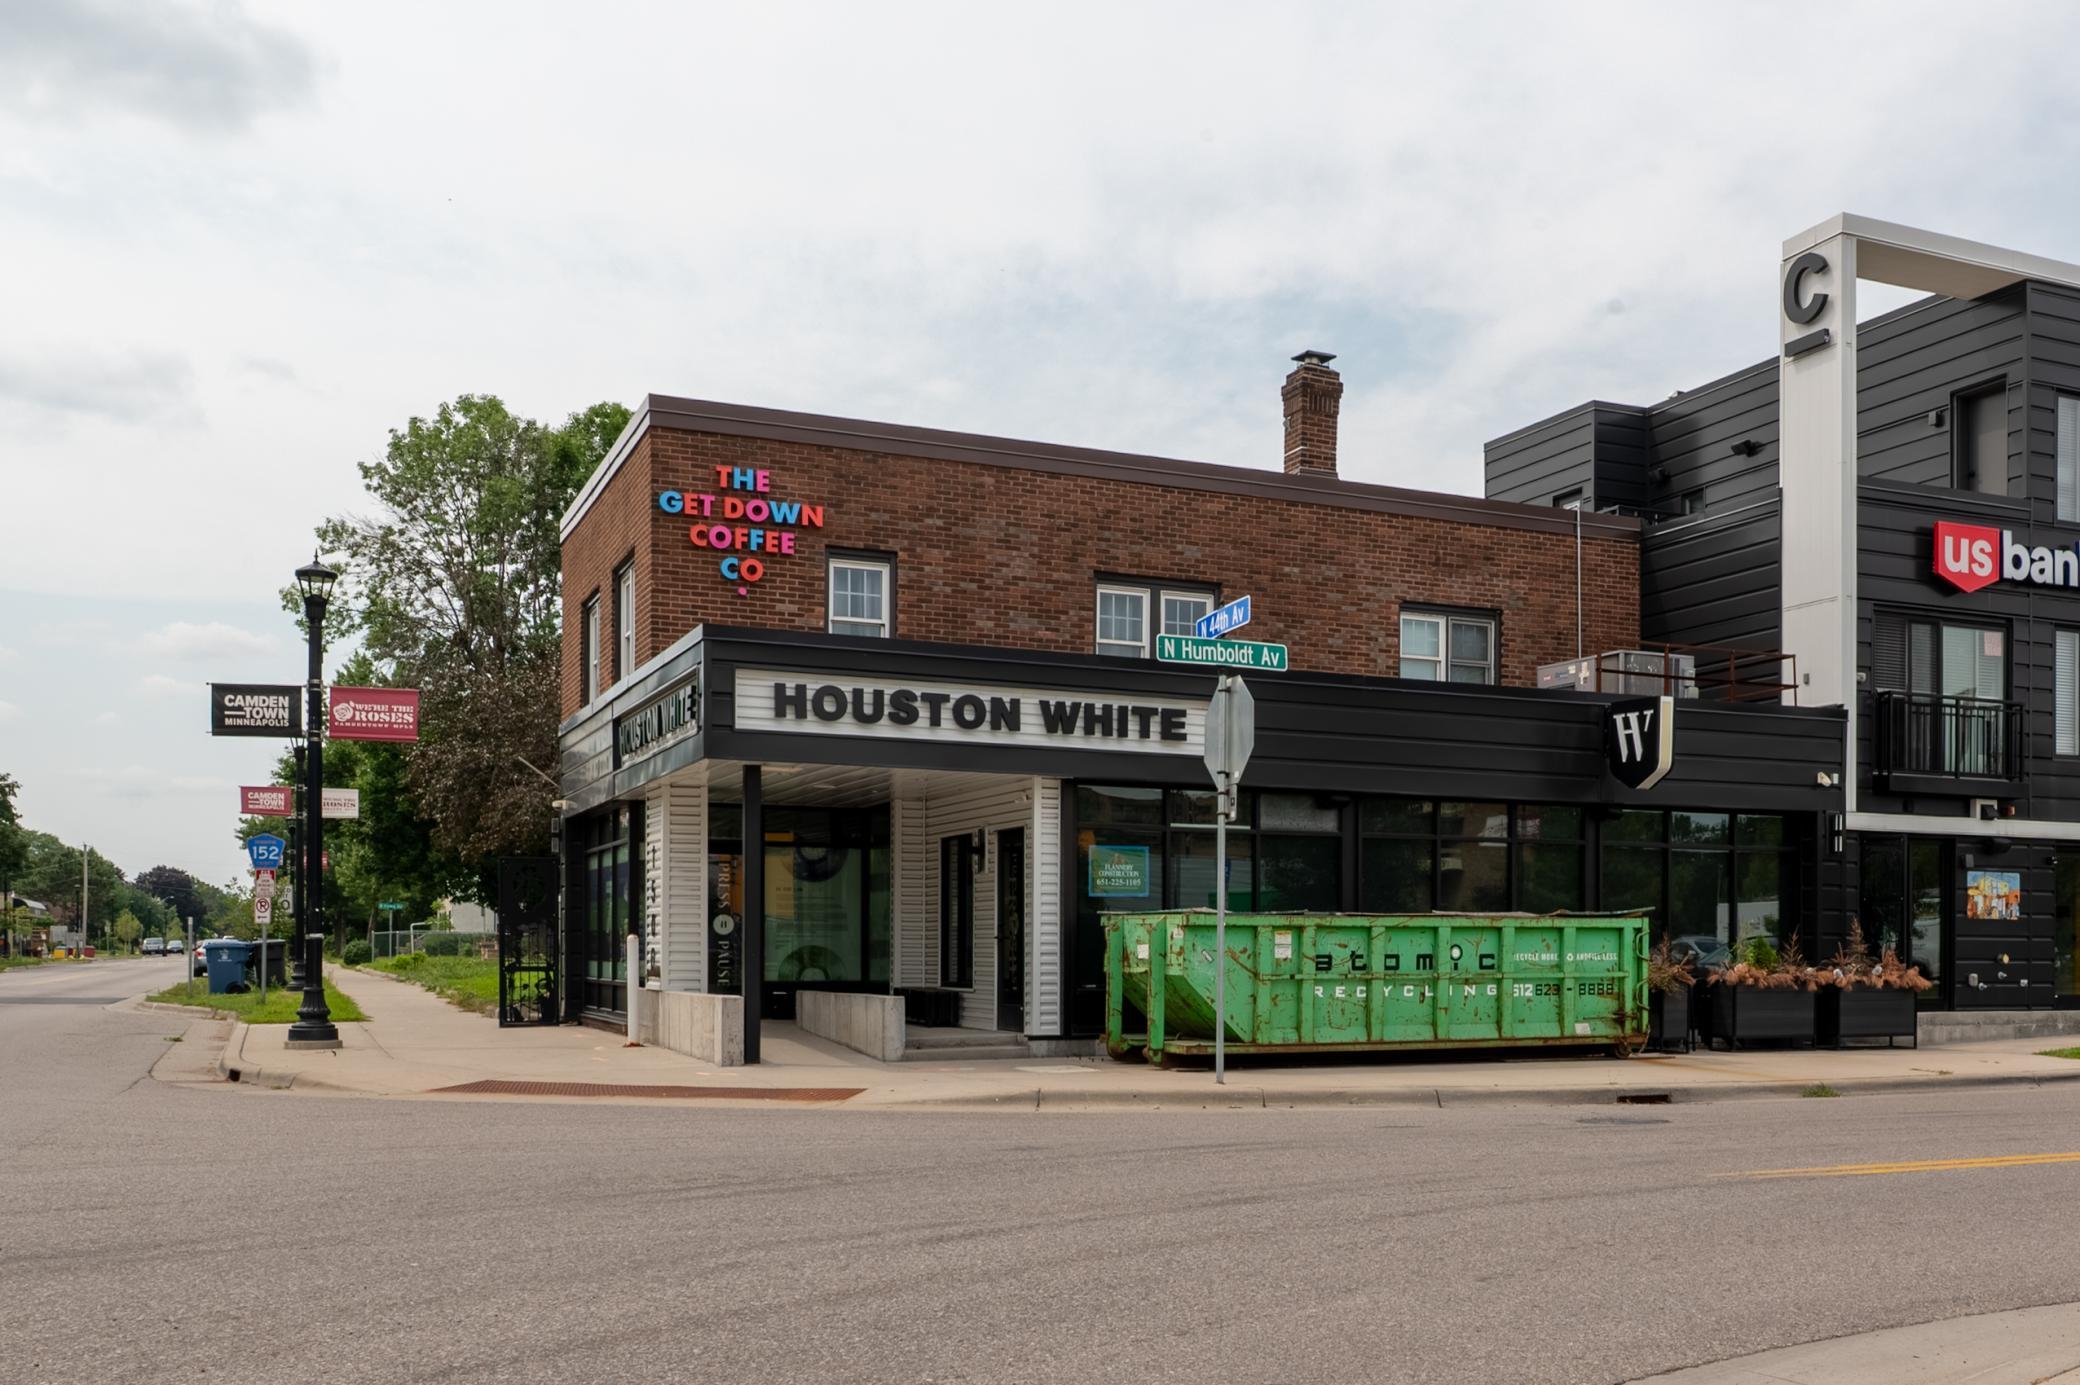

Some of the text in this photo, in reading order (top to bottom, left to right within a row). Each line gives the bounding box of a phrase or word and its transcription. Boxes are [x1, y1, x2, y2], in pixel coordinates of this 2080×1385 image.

[1783, 252, 1829, 325] C
[716, 465, 770, 493] THE
[659, 490, 824, 528] GET DOWN
[690, 524, 795, 555] COFFEE
[2002, 529, 2080, 587] ban
[1201, 605, 1244, 638] N 44th Av
[1164, 639, 1280, 667] N Humboldt Av
[224, 694, 290, 708] CAMDEN
[244, 707, 290, 720] TOWN
[391, 705, 414, 713] THE
[773, 683, 1188, 741] HOUSTON WHITE
[224, 718, 290, 727] MINNEAPOLIS
[354, 711, 414, 724] ROSES
[620, 685, 697, 756] HOUSTON WHITE
[248, 792, 285, 800] CAMDEN
[259, 799, 285, 807] TOWN
[252, 846, 279, 860] 152
[718, 862, 731, 908] PRESS
[717, 940, 730, 983] PAUSE
[1315, 943, 1496, 971] atomic
[1314, 984, 1498, 998] RECYCLING
